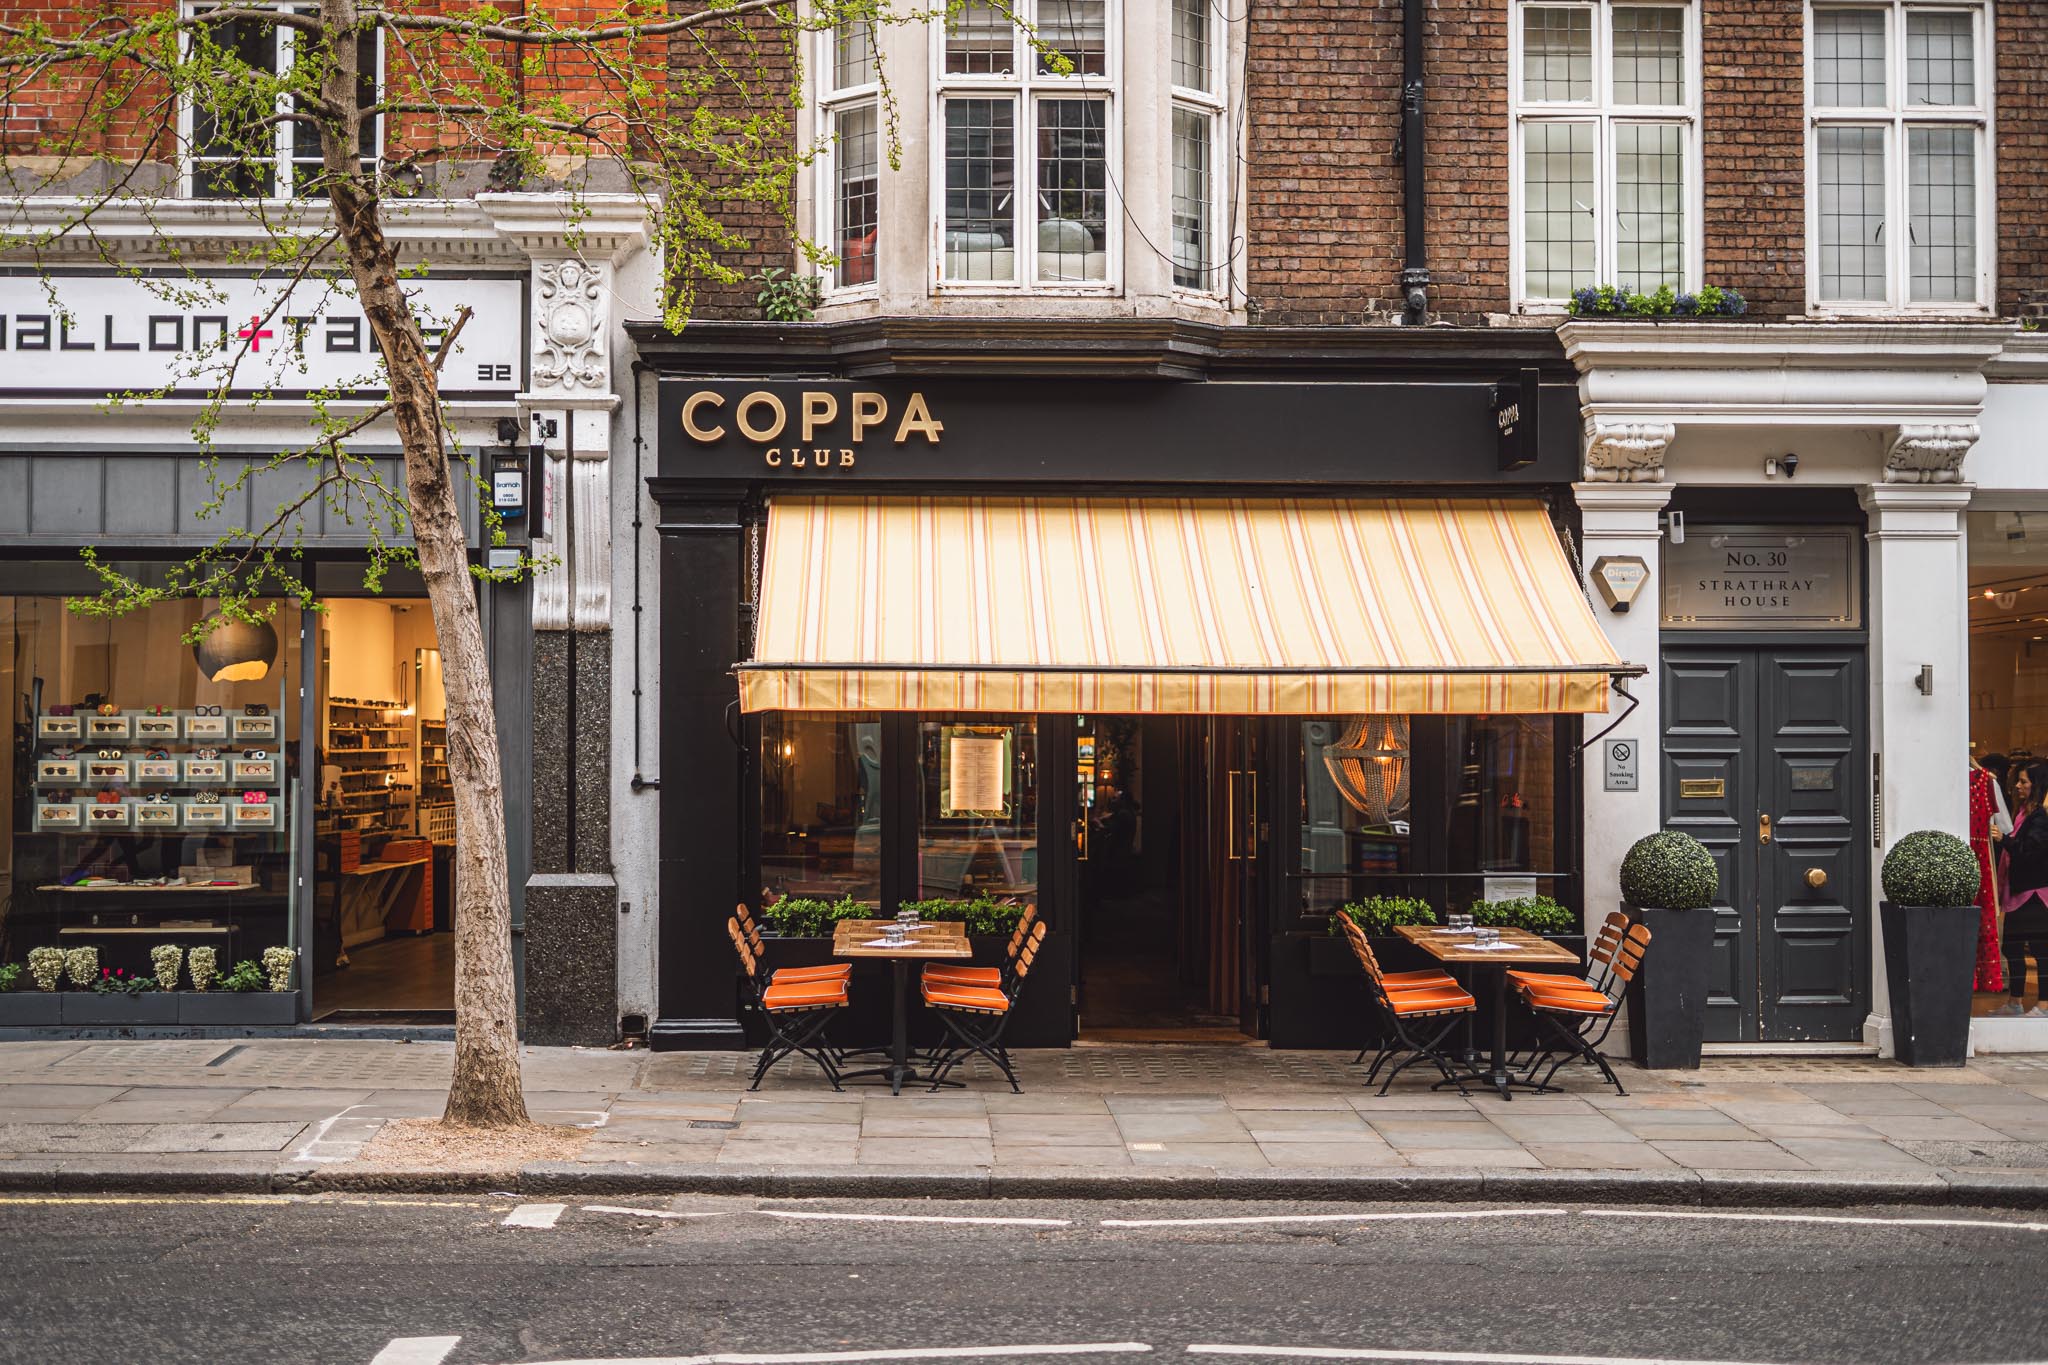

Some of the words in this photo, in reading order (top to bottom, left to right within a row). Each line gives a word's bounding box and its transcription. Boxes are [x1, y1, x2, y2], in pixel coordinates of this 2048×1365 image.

[478, 364, 511, 381] 32
[682, 391, 945, 442] COPPA
[765, 448, 855, 467] CLUB
[1727, 551, 1760, 567] No.
[1767, 551, 1787, 567] 30
[1699, 580, 1814, 591] STRATHRAY
[1725, 596, 1790, 607] HOUSE
